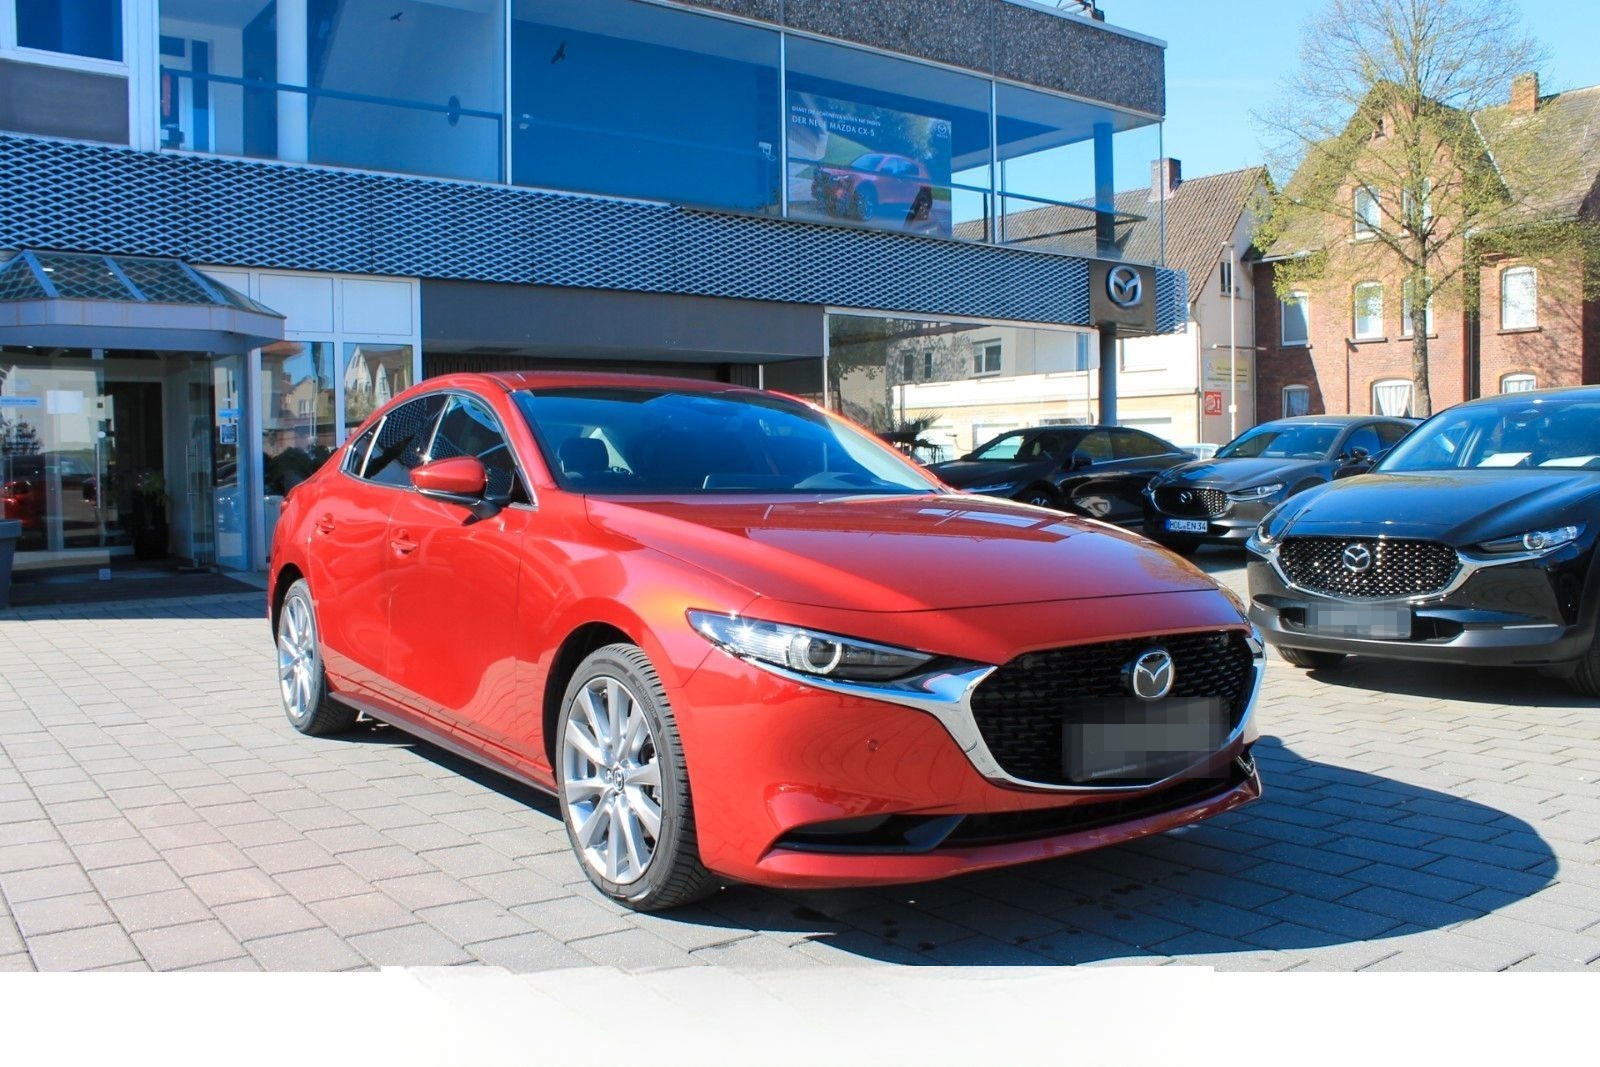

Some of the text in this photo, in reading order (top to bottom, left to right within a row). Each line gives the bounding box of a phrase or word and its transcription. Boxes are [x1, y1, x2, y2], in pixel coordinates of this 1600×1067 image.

[792, 115, 807, 125] DER
[829, 122, 856, 133] MAZDA
[857, 127, 875, 137] CX-5
